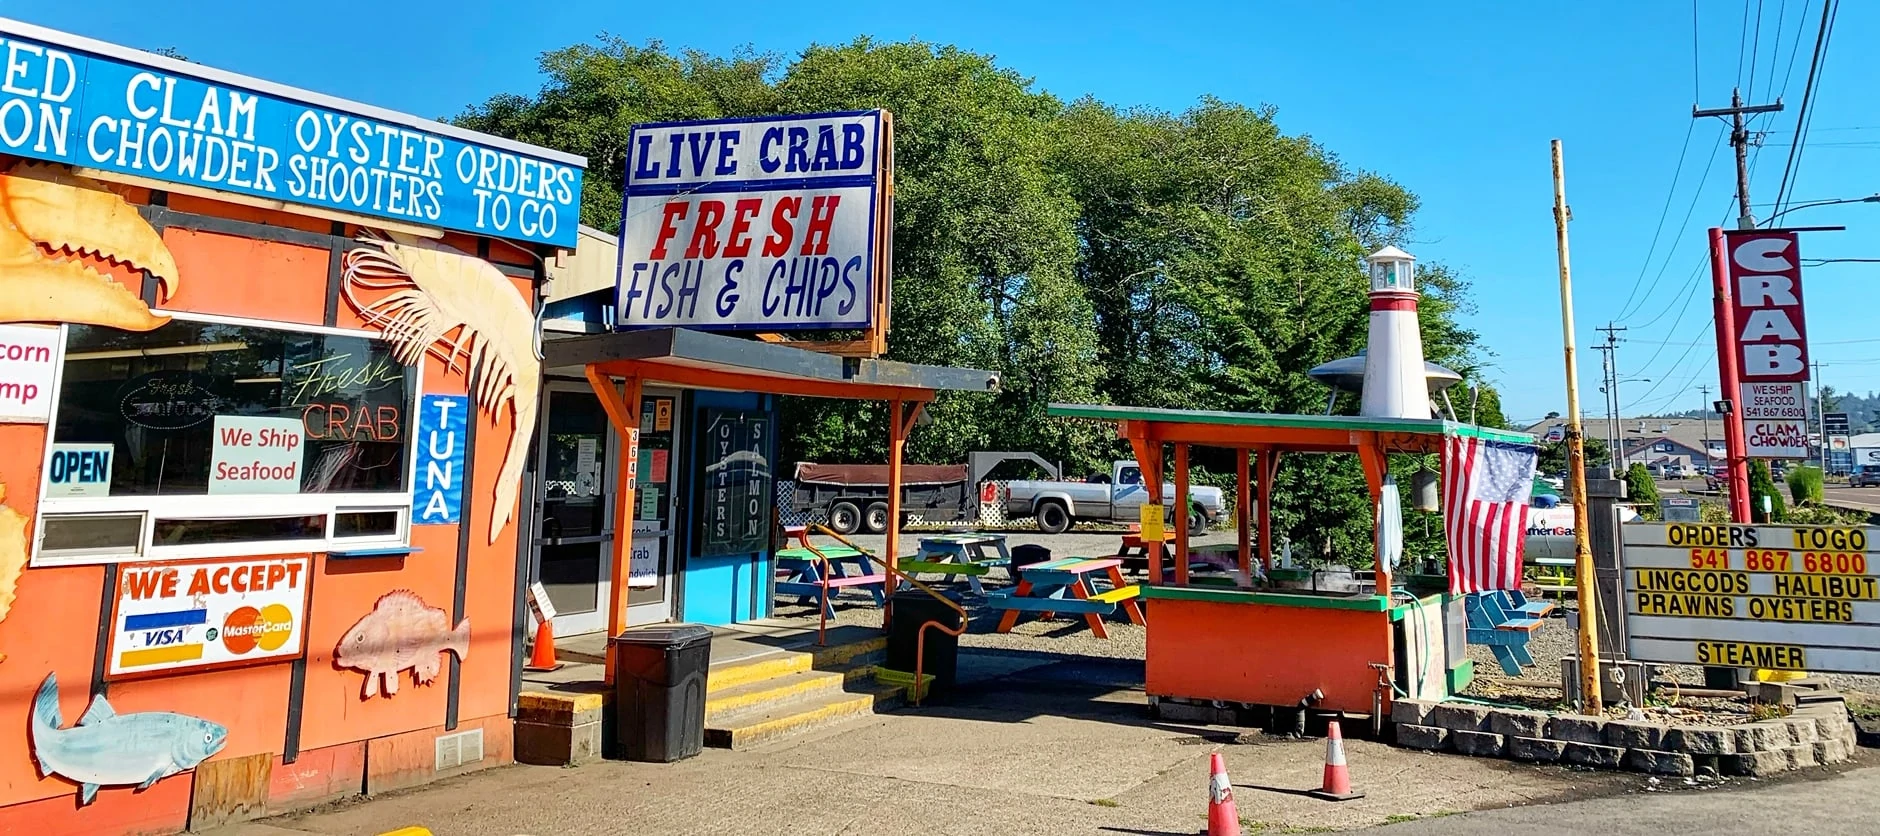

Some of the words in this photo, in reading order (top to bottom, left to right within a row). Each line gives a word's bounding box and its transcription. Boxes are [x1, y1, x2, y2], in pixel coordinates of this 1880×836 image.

[0, 38, 76, 103] ED
[0, 98, 72, 157] ON
[126, 72, 259, 141] CLAM
[87, 115, 279, 192] CHOWDER
[295, 110, 444, 179] OYSTER
[634, 130, 740, 180] LIVE
[760, 123, 865, 173] CRAB
[285, 154, 444, 220] SHOOTERS
[456, 145, 574, 205] ORDERS
[473, 188, 511, 231] TO
[519, 199, 557, 238] GO
[649, 195, 841, 260] FRESH
[624, 259, 703, 320] FISH
[716, 259, 745, 318] &
[762, 255, 862, 318] CHIPS
[1733, 238, 1805, 377] CRAB
[291, 352, 403, 406] Fresh
[1754, 396, 1796, 406] SEAFOOD
[303, 403, 399, 441] CRAB
[1746, 407, 1761, 417] 541
[1763, 407, 1780, 417] 867
[1781, 407, 1806, 417] 6800
[1755, 423, 1800, 436] CLAM
[220, 427, 253, 447] We
[257, 427, 300, 452] Ship
[422, 400, 457, 520] TUNA
[629, 430, 638, 490] 3640
[1750, 434, 1809, 448] CHOWDER
[50, 450, 110, 484] OPEN
[215, 460, 297, 481] Seafood
[716, 424, 730, 537] OYSTERS
[747, 423, 761, 536] SALMON
[630, 546, 650, 560] rab
[1668, 525, 1759, 547] ORDERS
[128, 569, 179, 600] WE
[187, 563, 302, 596] ACCEPT
[1691, 549, 1729, 569] 541
[1746, 551, 1790, 571] 867
[1803, 552, 1866, 574] 6800
[1636, 570, 1749, 593] LINGCODS
[1775, 575, 1876, 599] HALIBUT
[1637, 593, 1734, 617] PRAWNS
[1749, 598, 1852, 621] OYSTERS
[144, 629, 183, 647] VISA
[223, 621, 291, 638] MasterCard
[1697, 642, 1805, 668] STEAMER
